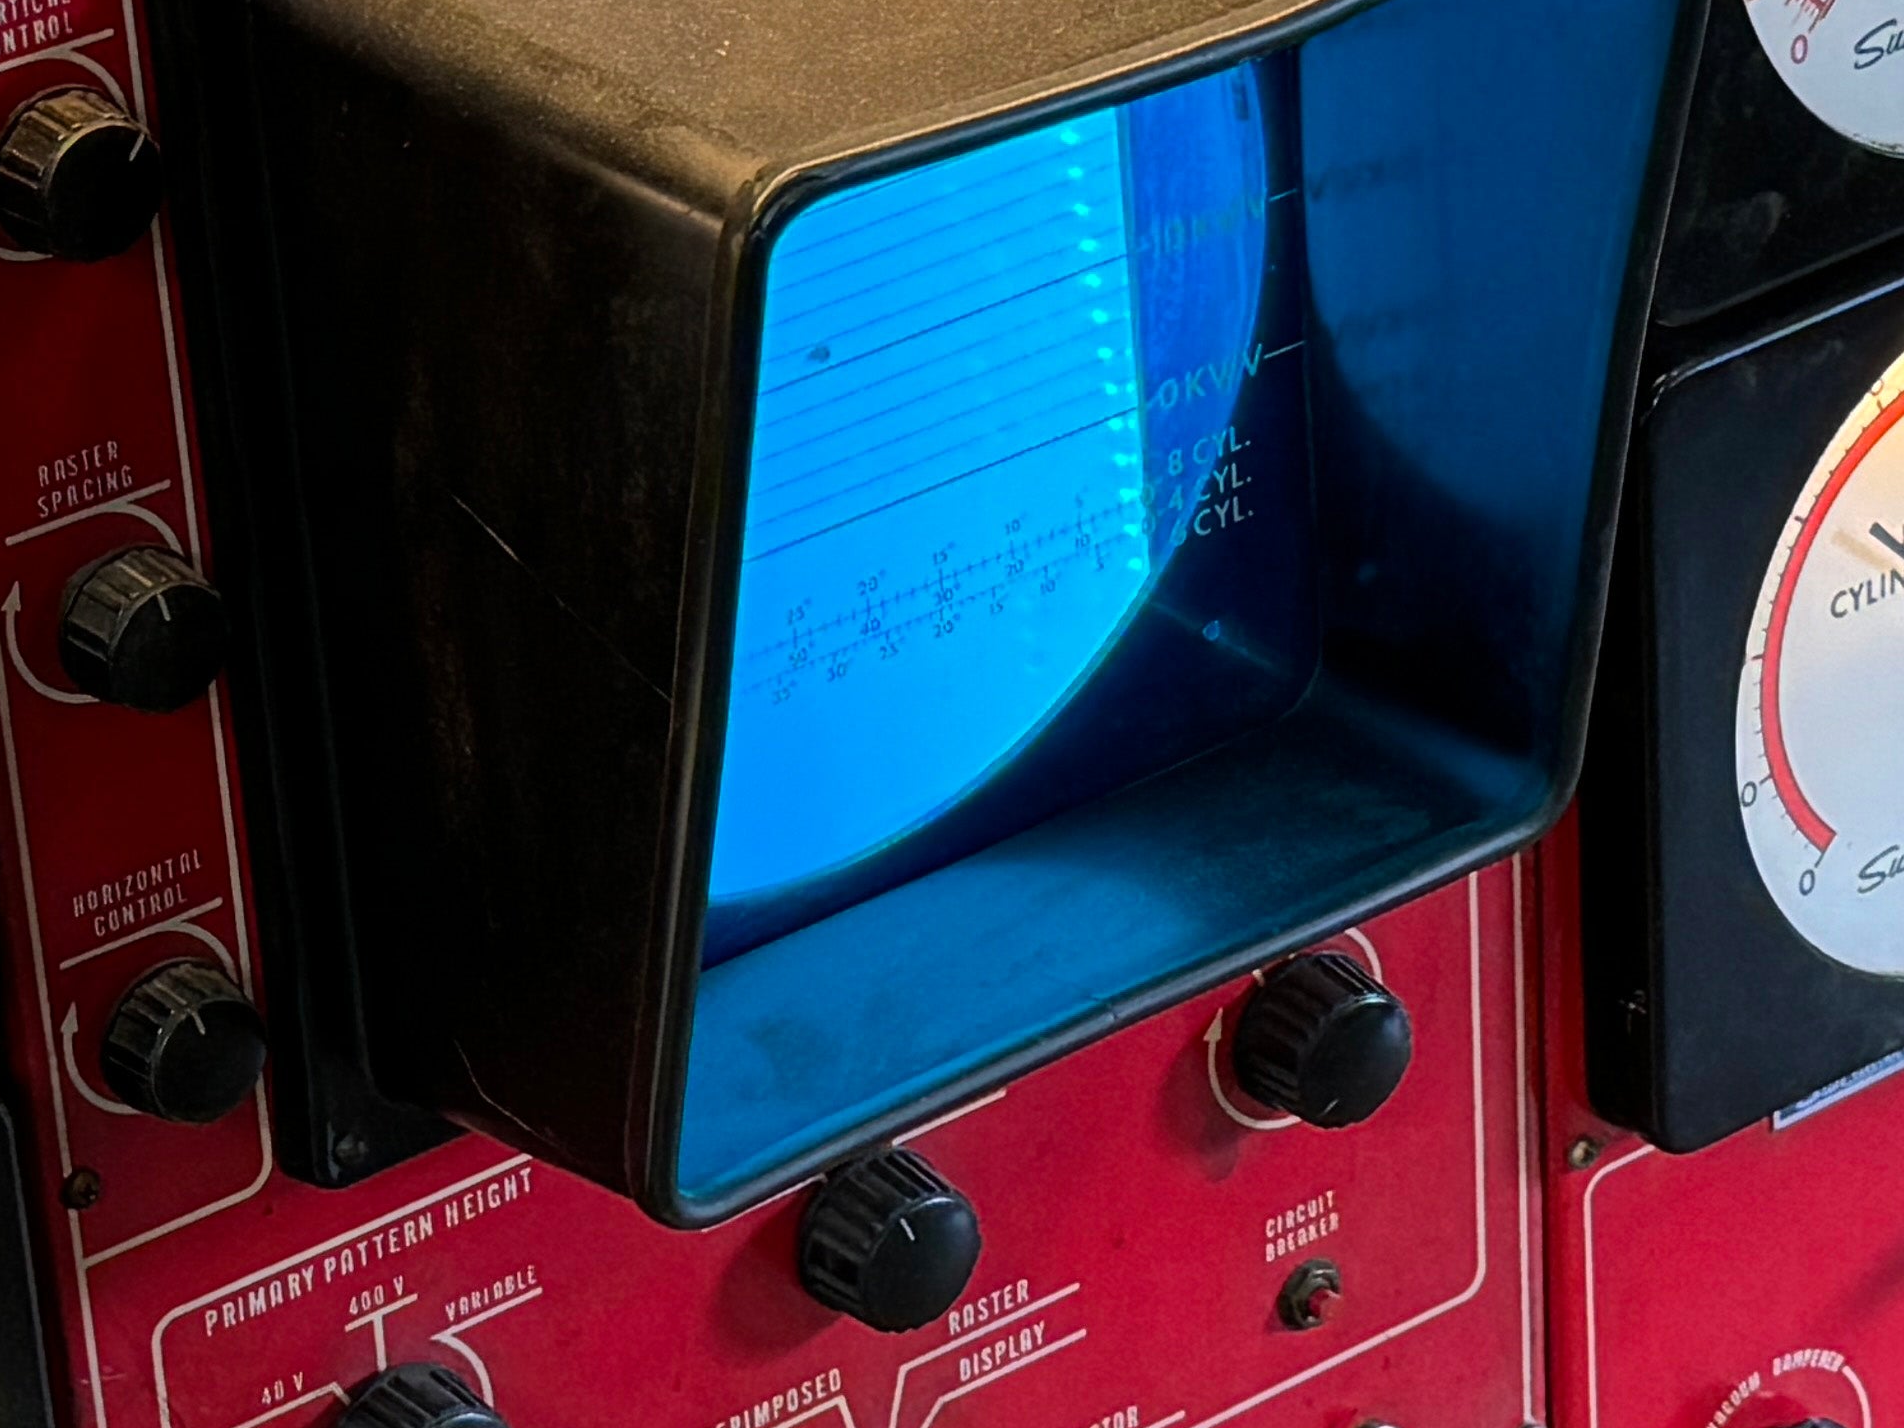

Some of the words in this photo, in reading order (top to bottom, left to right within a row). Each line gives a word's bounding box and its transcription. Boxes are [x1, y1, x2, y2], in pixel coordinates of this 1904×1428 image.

[37, 464, 132, 518] SPACING
[38, 440, 117, 488] RASTER
[72, 849, 202, 918] HORIZONTAL
[94, 883, 187, 937] CONTROL
[1265, 1189, 1337, 1239] CIRCUIT
[1265, 1212, 1340, 1263] BREAKER
[204, 1265, 315, 1337] PRIMARY
[323, 1211, 434, 1284] PATTERN
[444, 1167, 533, 1229] HEIGHT
[348, 1283, 385, 1316] 400
[393, 1275, 406, 1296] V
[445, 1264, 538, 1322] VARIABLE
[947, 1278, 1031, 1336] RASTER
[958, 1320, 1048, 1382] DISPLAY
[261, 1380, 285, 1406] 40
[292, 1371, 304, 1392] V
